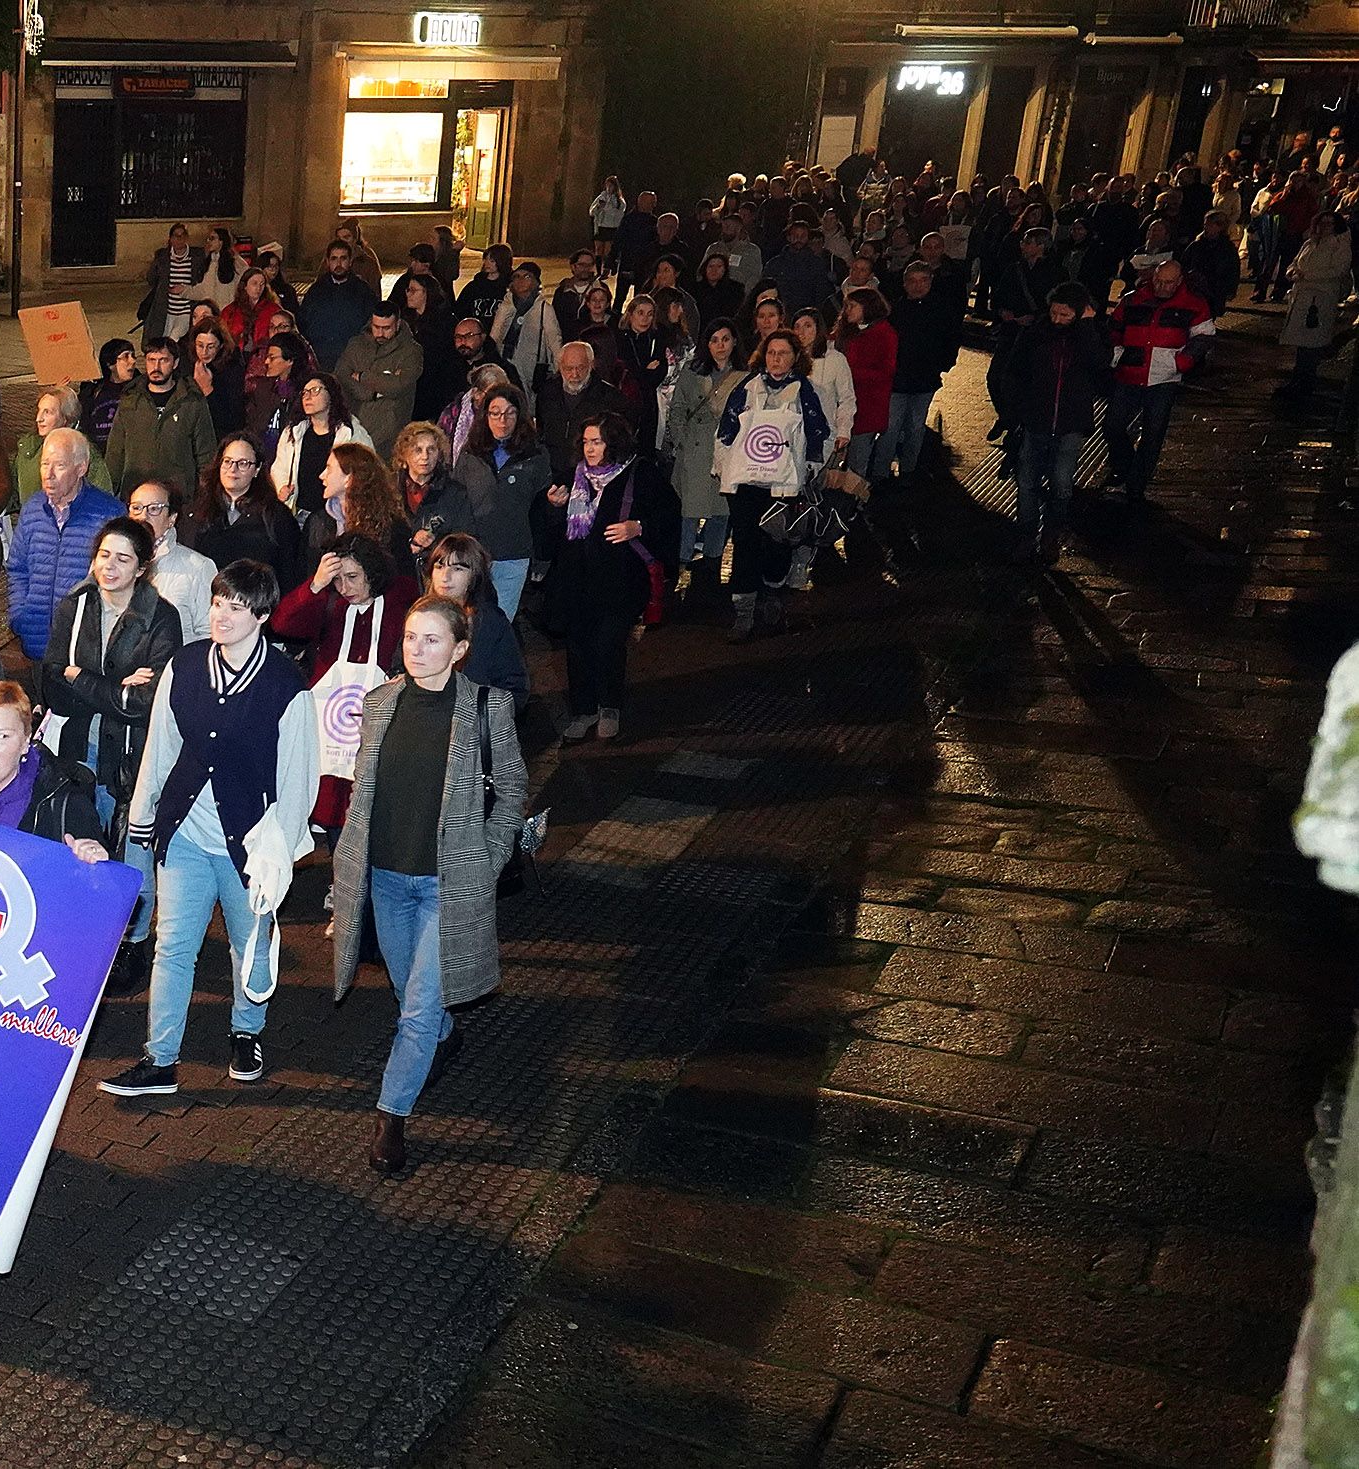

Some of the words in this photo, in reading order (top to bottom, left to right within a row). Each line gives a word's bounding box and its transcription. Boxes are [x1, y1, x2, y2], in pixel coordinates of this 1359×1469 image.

[430, 15, 480, 43] ACUÑA
[138, 77, 190, 89] TABACOS
[195, 73, 242, 87] UMADOR
[937, 71, 965, 96] 36
